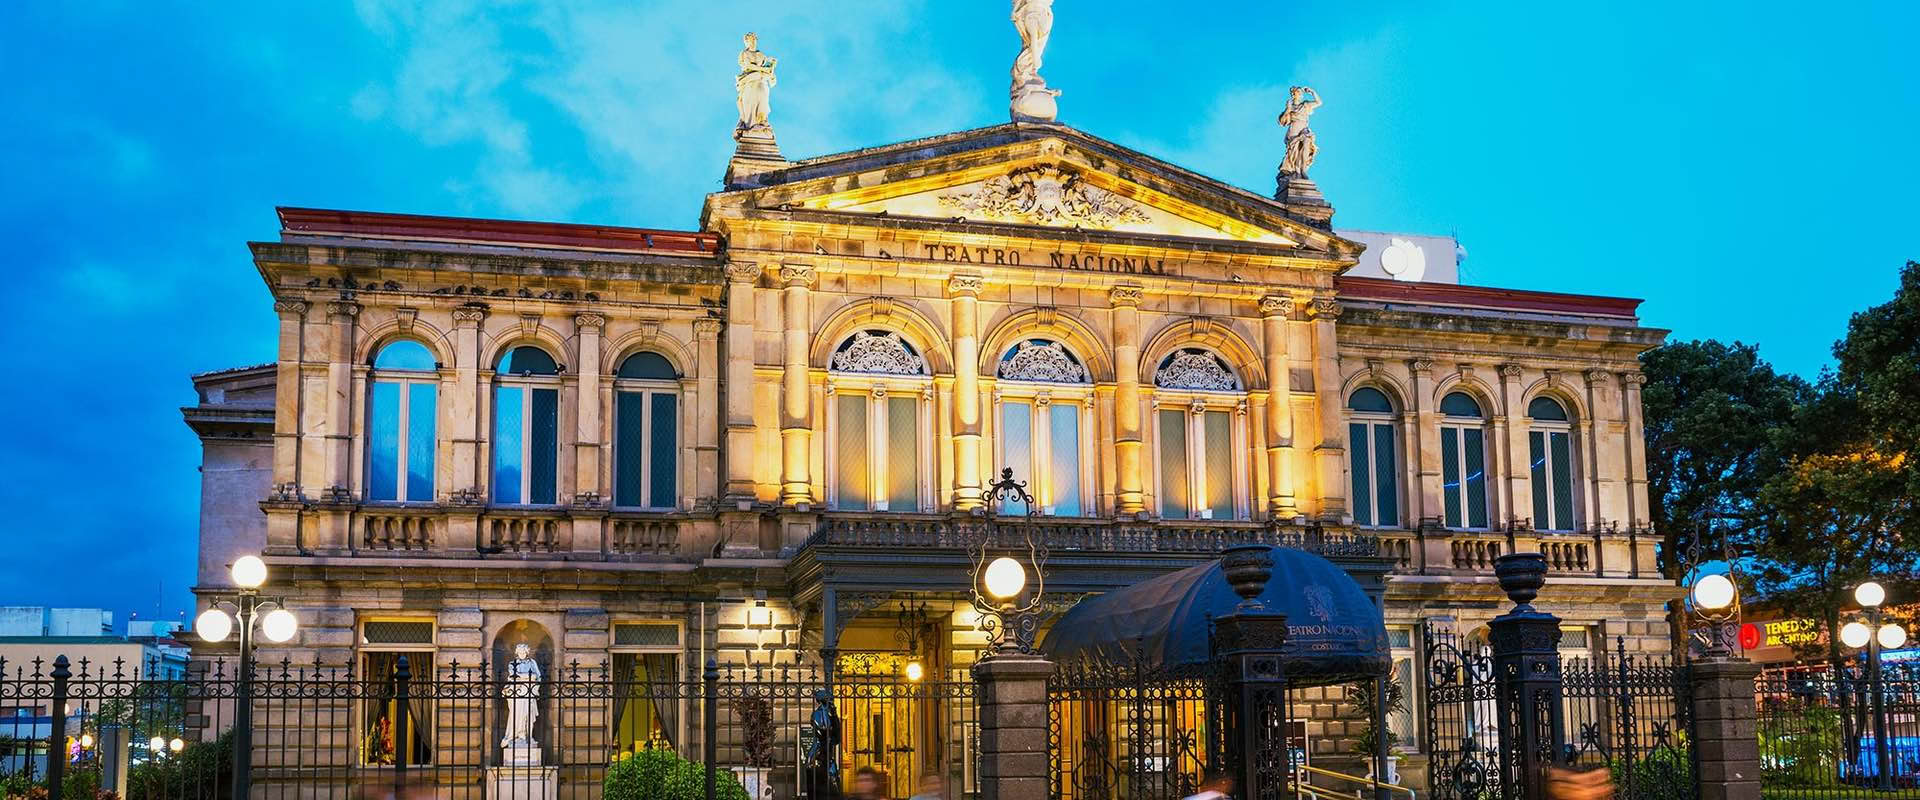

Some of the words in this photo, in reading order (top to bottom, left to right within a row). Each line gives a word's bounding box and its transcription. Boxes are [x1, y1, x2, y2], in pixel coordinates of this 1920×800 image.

[925, 244, 1021, 267] TEATRO
[1049, 252, 1168, 276] NACIONAL
[1287, 624, 1322, 636] EATRO
[1765, 618, 1815, 635] TENEDOR
[1766, 631, 1818, 646] ARGENTINO
